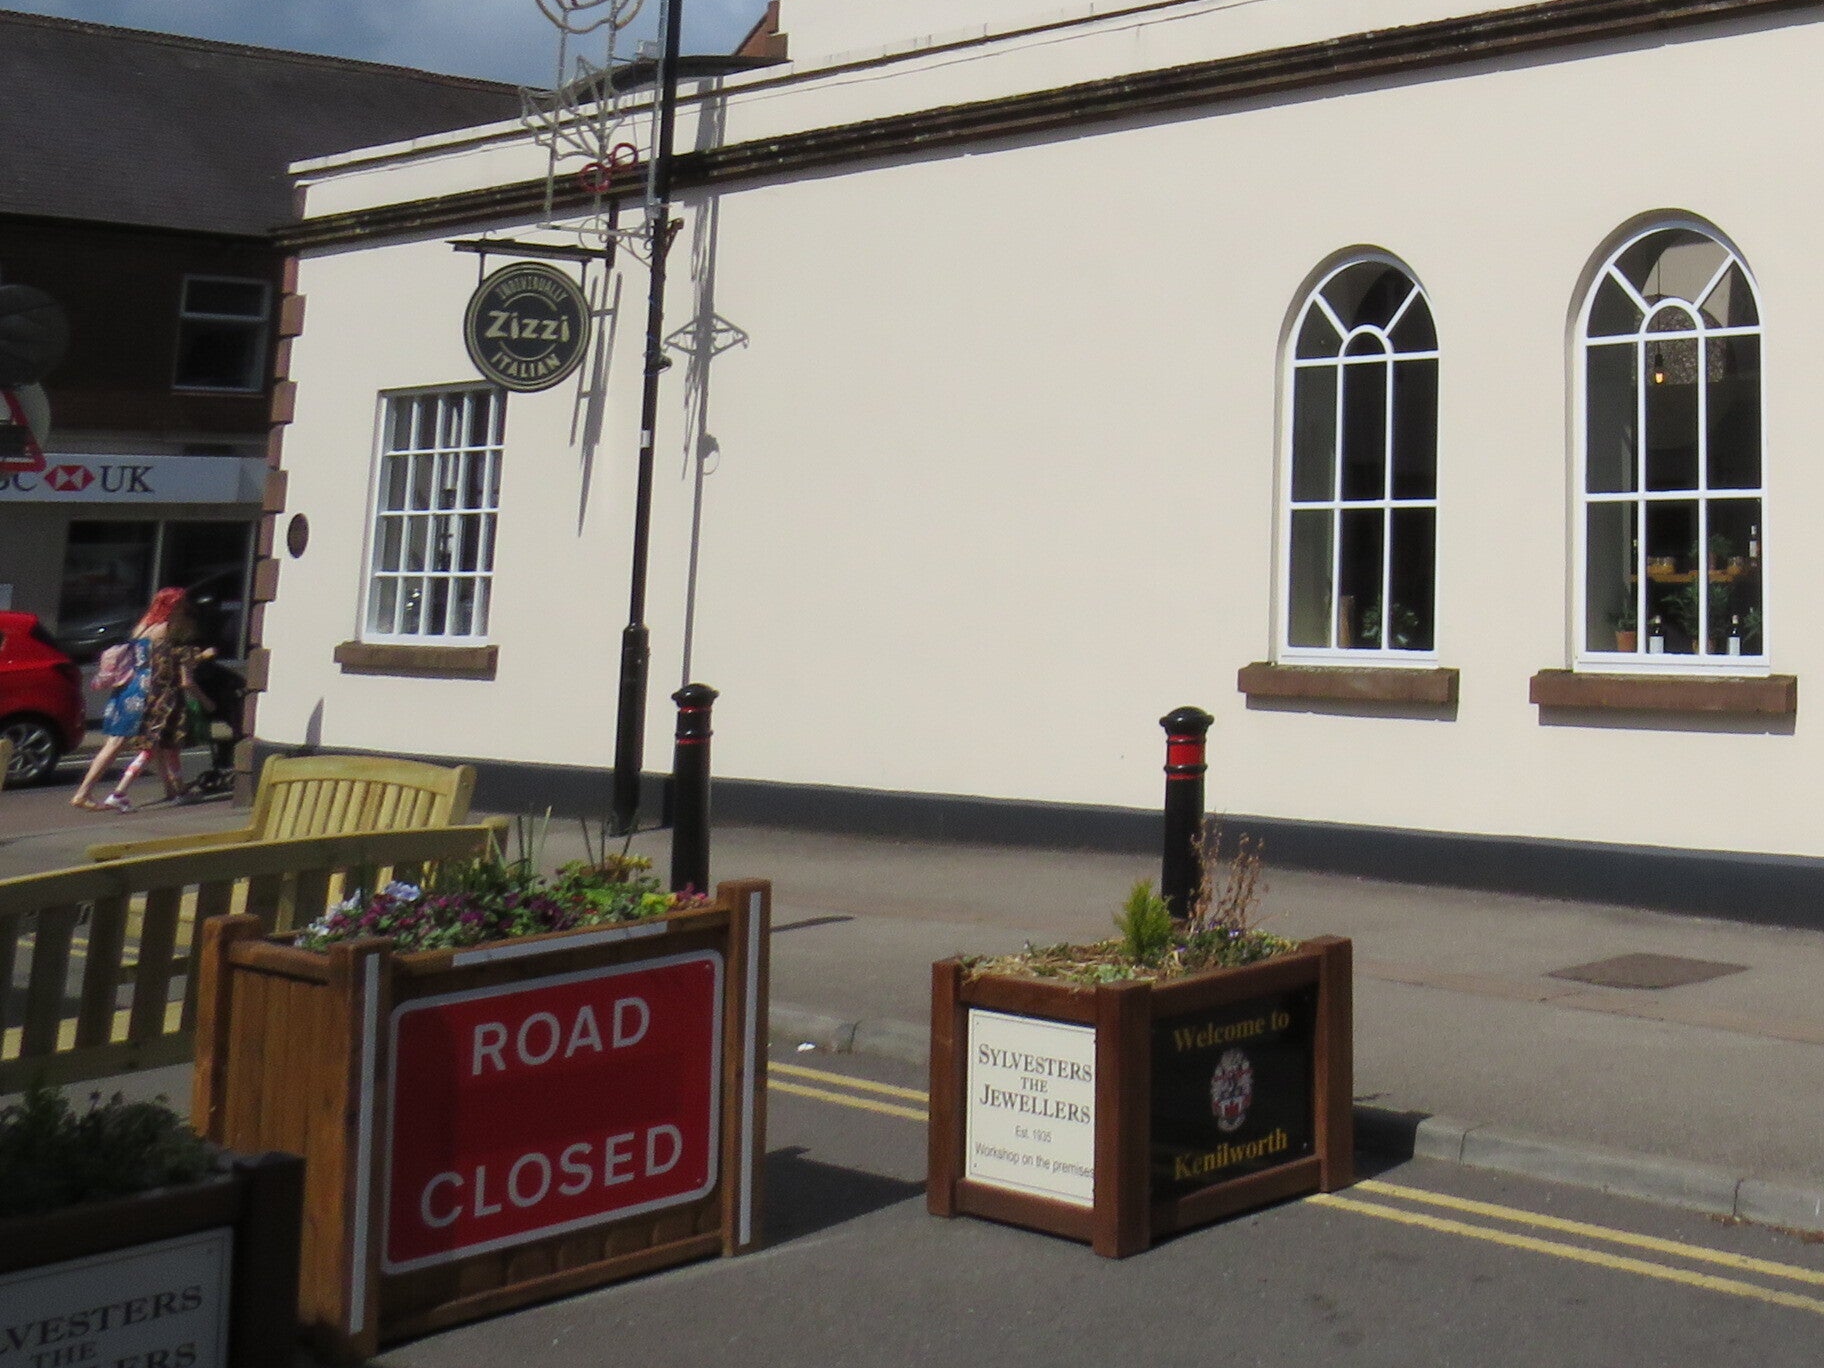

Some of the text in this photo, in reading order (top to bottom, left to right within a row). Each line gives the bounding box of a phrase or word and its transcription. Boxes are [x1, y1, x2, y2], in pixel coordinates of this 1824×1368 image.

[496, 275, 570, 303] INDIVIDUALLY
[484, 310, 571, 343] Zizzi
[490, 351, 561, 378] ITALIAN
[100, 465, 155, 494] UK
[471, 996, 651, 1076] ROAD
[1174, 1010, 1290, 1052] Welcome to
[978, 1043, 1093, 1083] SYLVESTERS
[1020, 1076, 1048, 1093] THE
[979, 1083, 1091, 1124] JEWELLERS
[975, 1141, 1020, 1164] Workshop
[1021, 1153, 1034, 1166] on
[1036, 1154, 1051, 1170] the
[1174, 1127, 1289, 1181] Kenilworth
[419, 1124, 684, 1229] CLOSED
